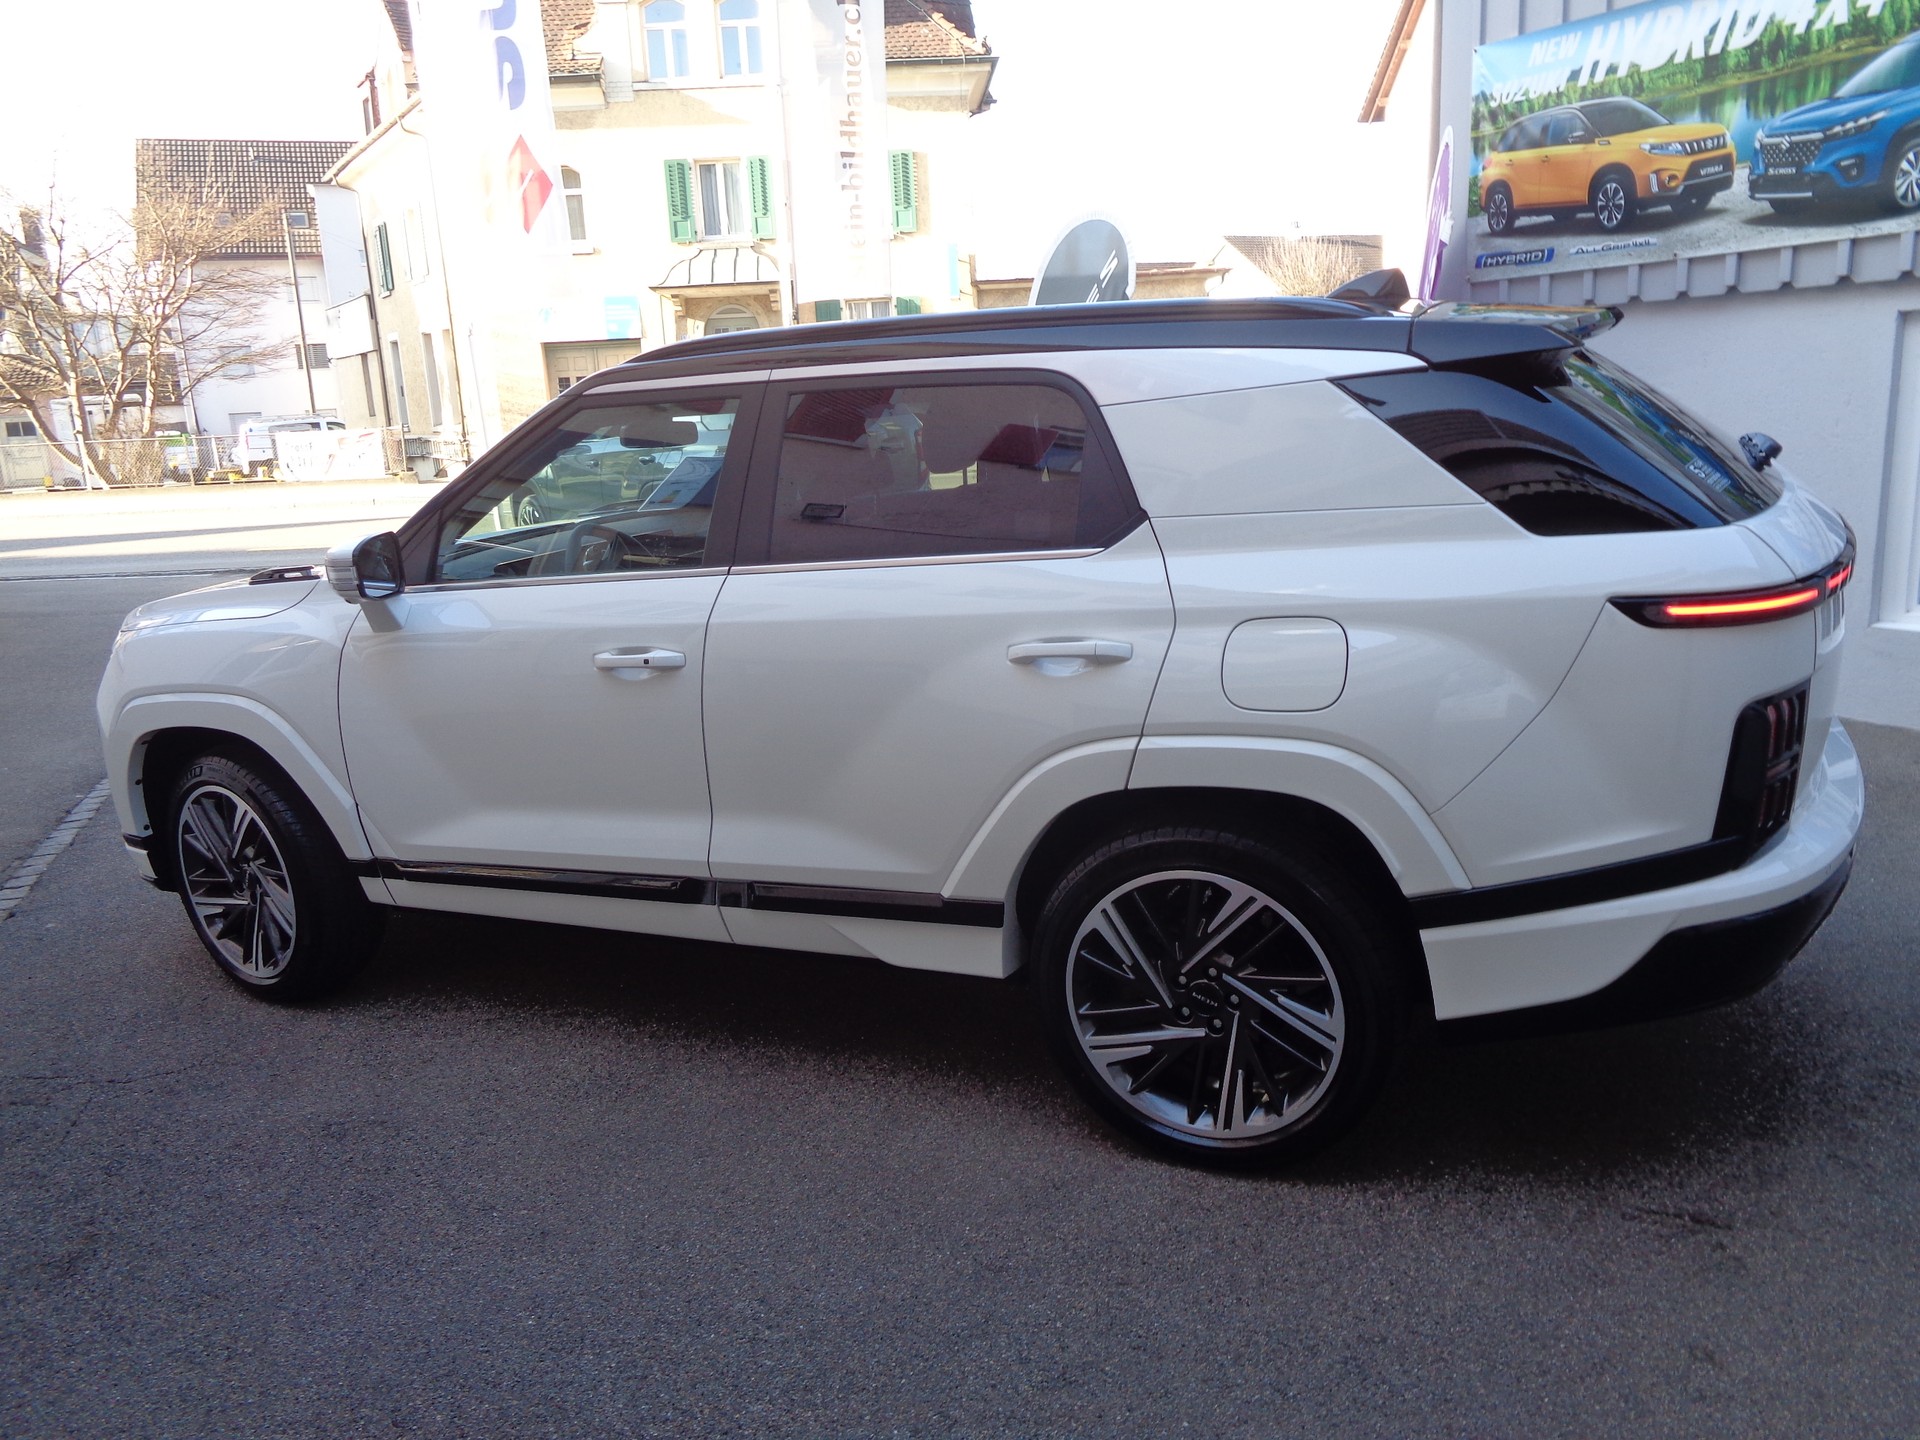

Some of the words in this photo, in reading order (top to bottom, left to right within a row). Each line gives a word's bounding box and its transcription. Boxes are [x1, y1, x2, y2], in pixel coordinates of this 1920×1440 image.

[1528, 31, 1582, 67] NEW
[1578, 0, 1776, 87] HYBRID
[1490, 67, 1571, 107] SUZUKI
[836, 0, 866, 276] ein-bildhauer.c
[1486, 250, 1543, 266] HYBRID
